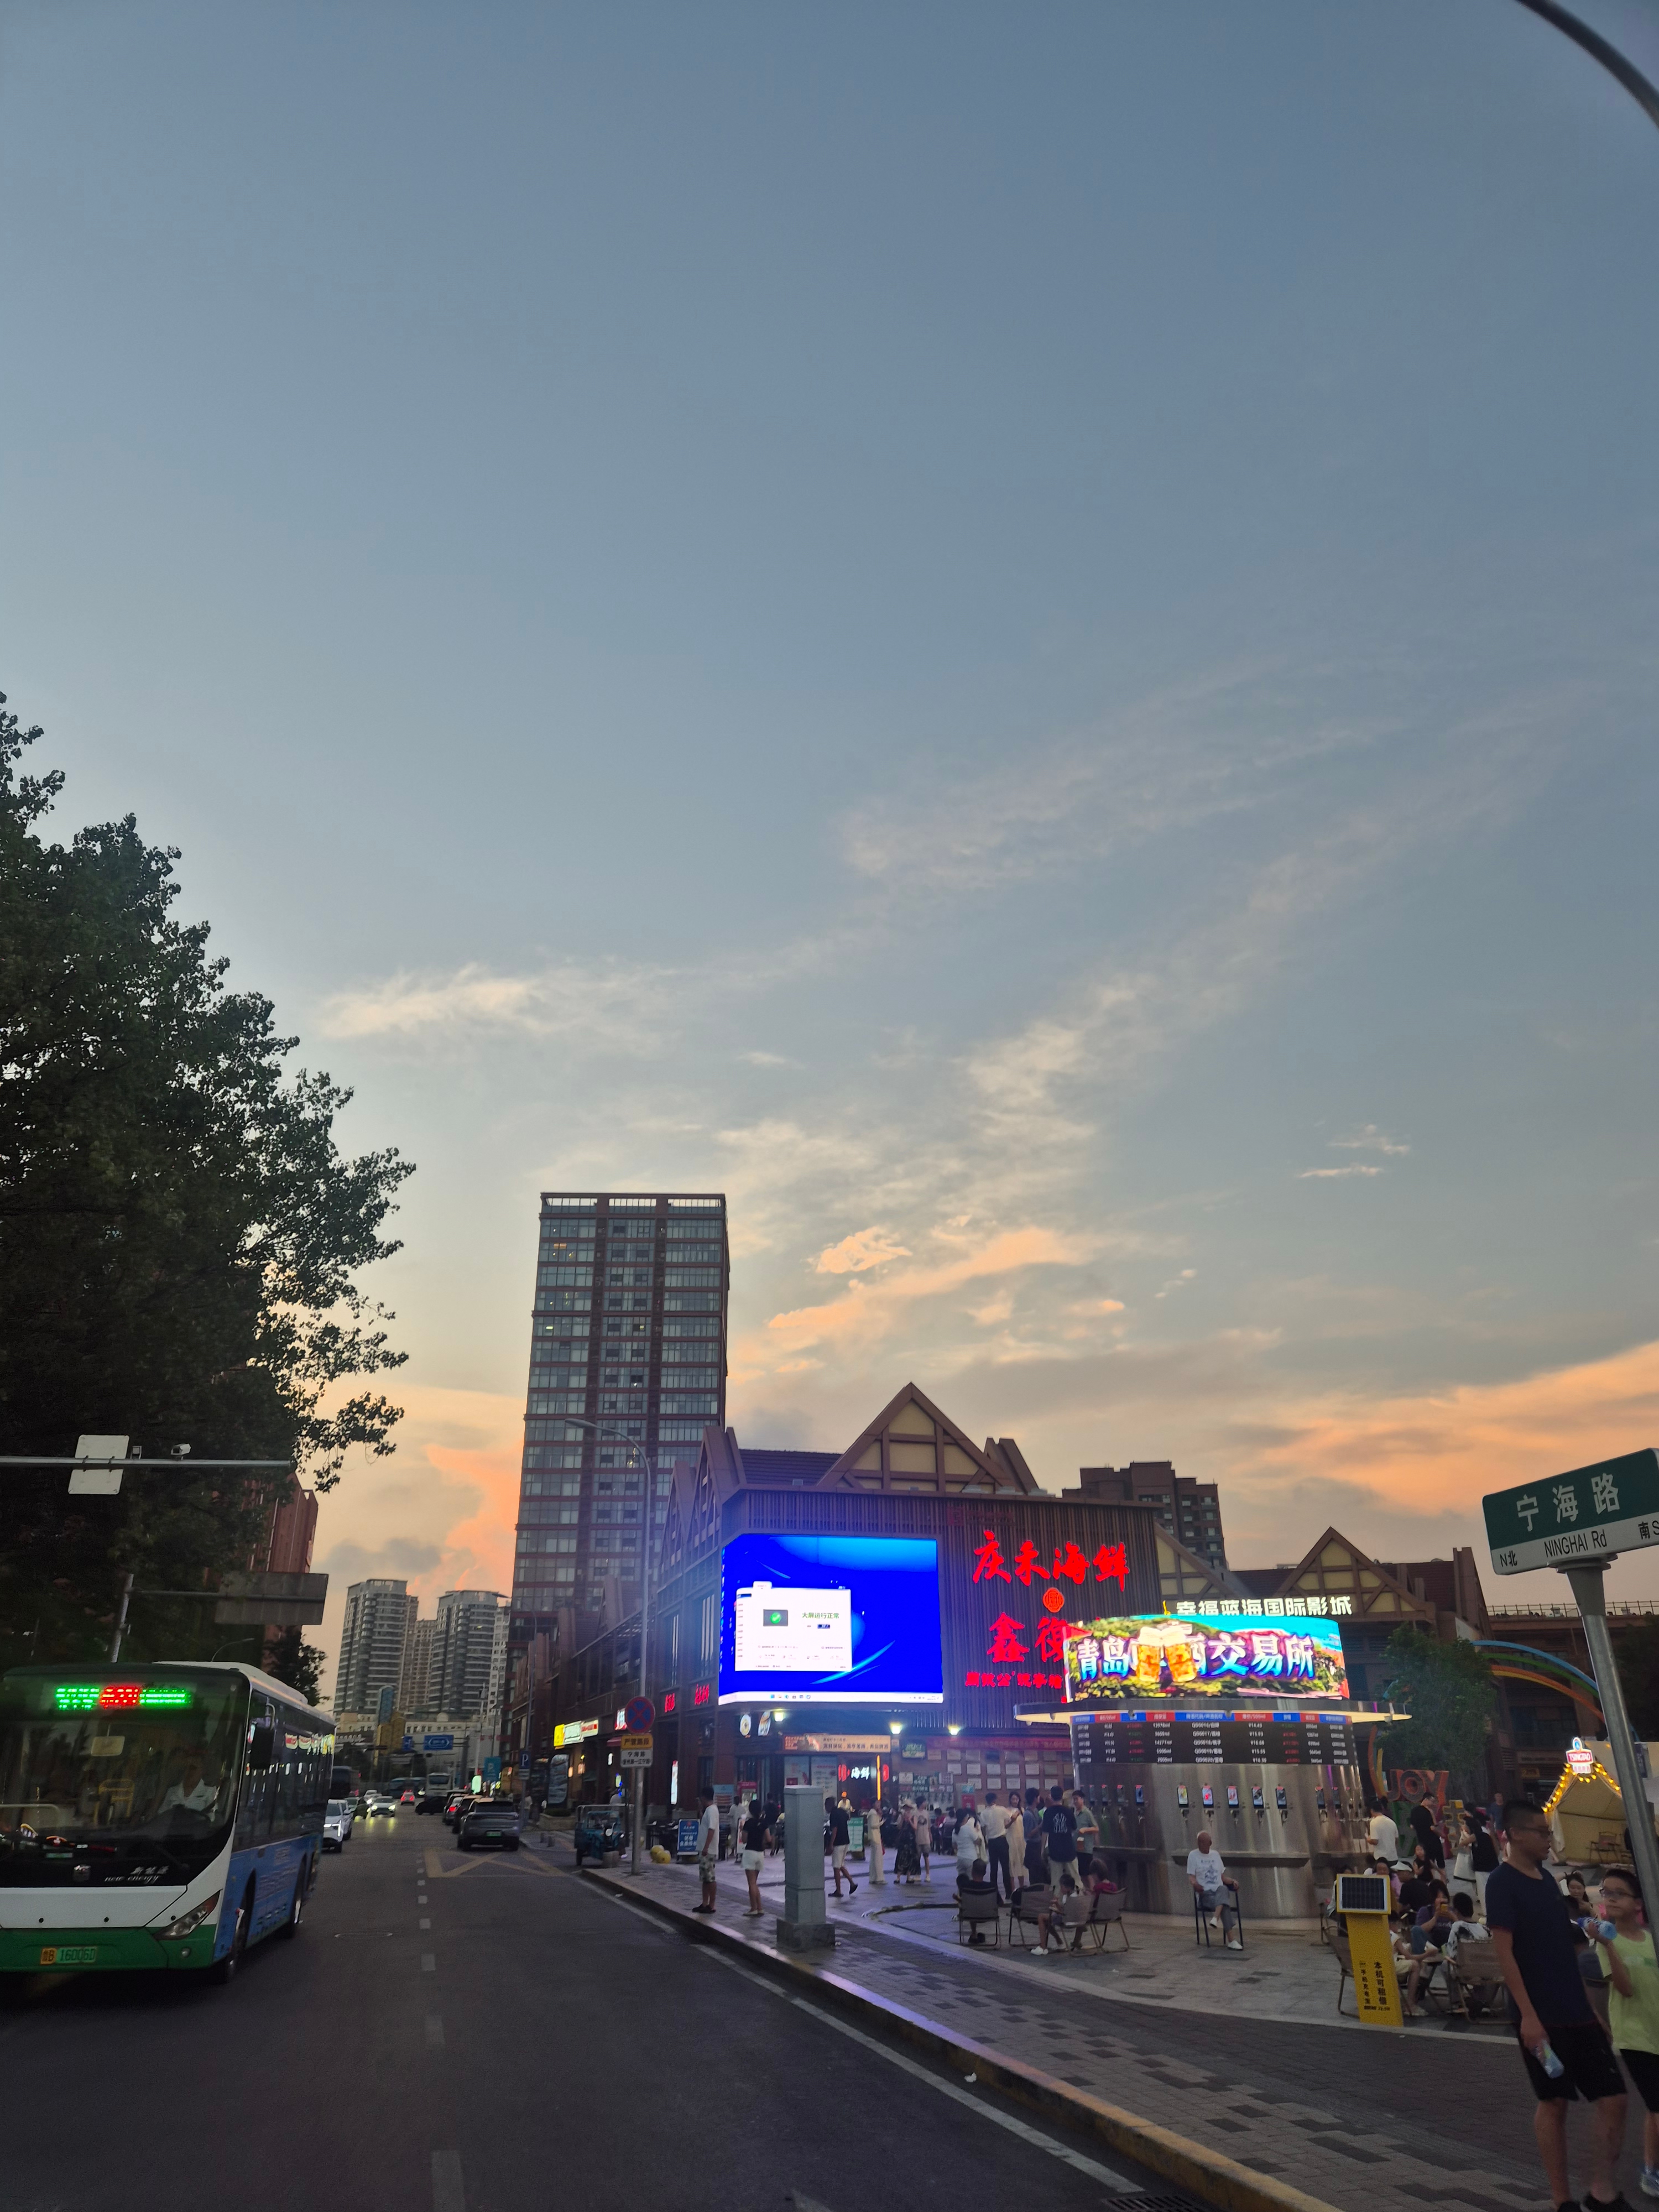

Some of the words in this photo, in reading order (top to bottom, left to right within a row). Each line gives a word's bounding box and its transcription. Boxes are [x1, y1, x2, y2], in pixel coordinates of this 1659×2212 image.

[1516, 1473, 1620, 1532] 宁海路
[1544, 1533, 1588, 1558] NINGHAI
[1592, 1529, 1607, 1550] Rd
[972, 1530, 1129, 1592] 庆禾海鲜
[1176, 1596, 1353, 1617] 幸福蓝海国际影城
[521, 1754, 529, 1767] P
[1568, 1752, 1591, 1762] TSINGTAO
